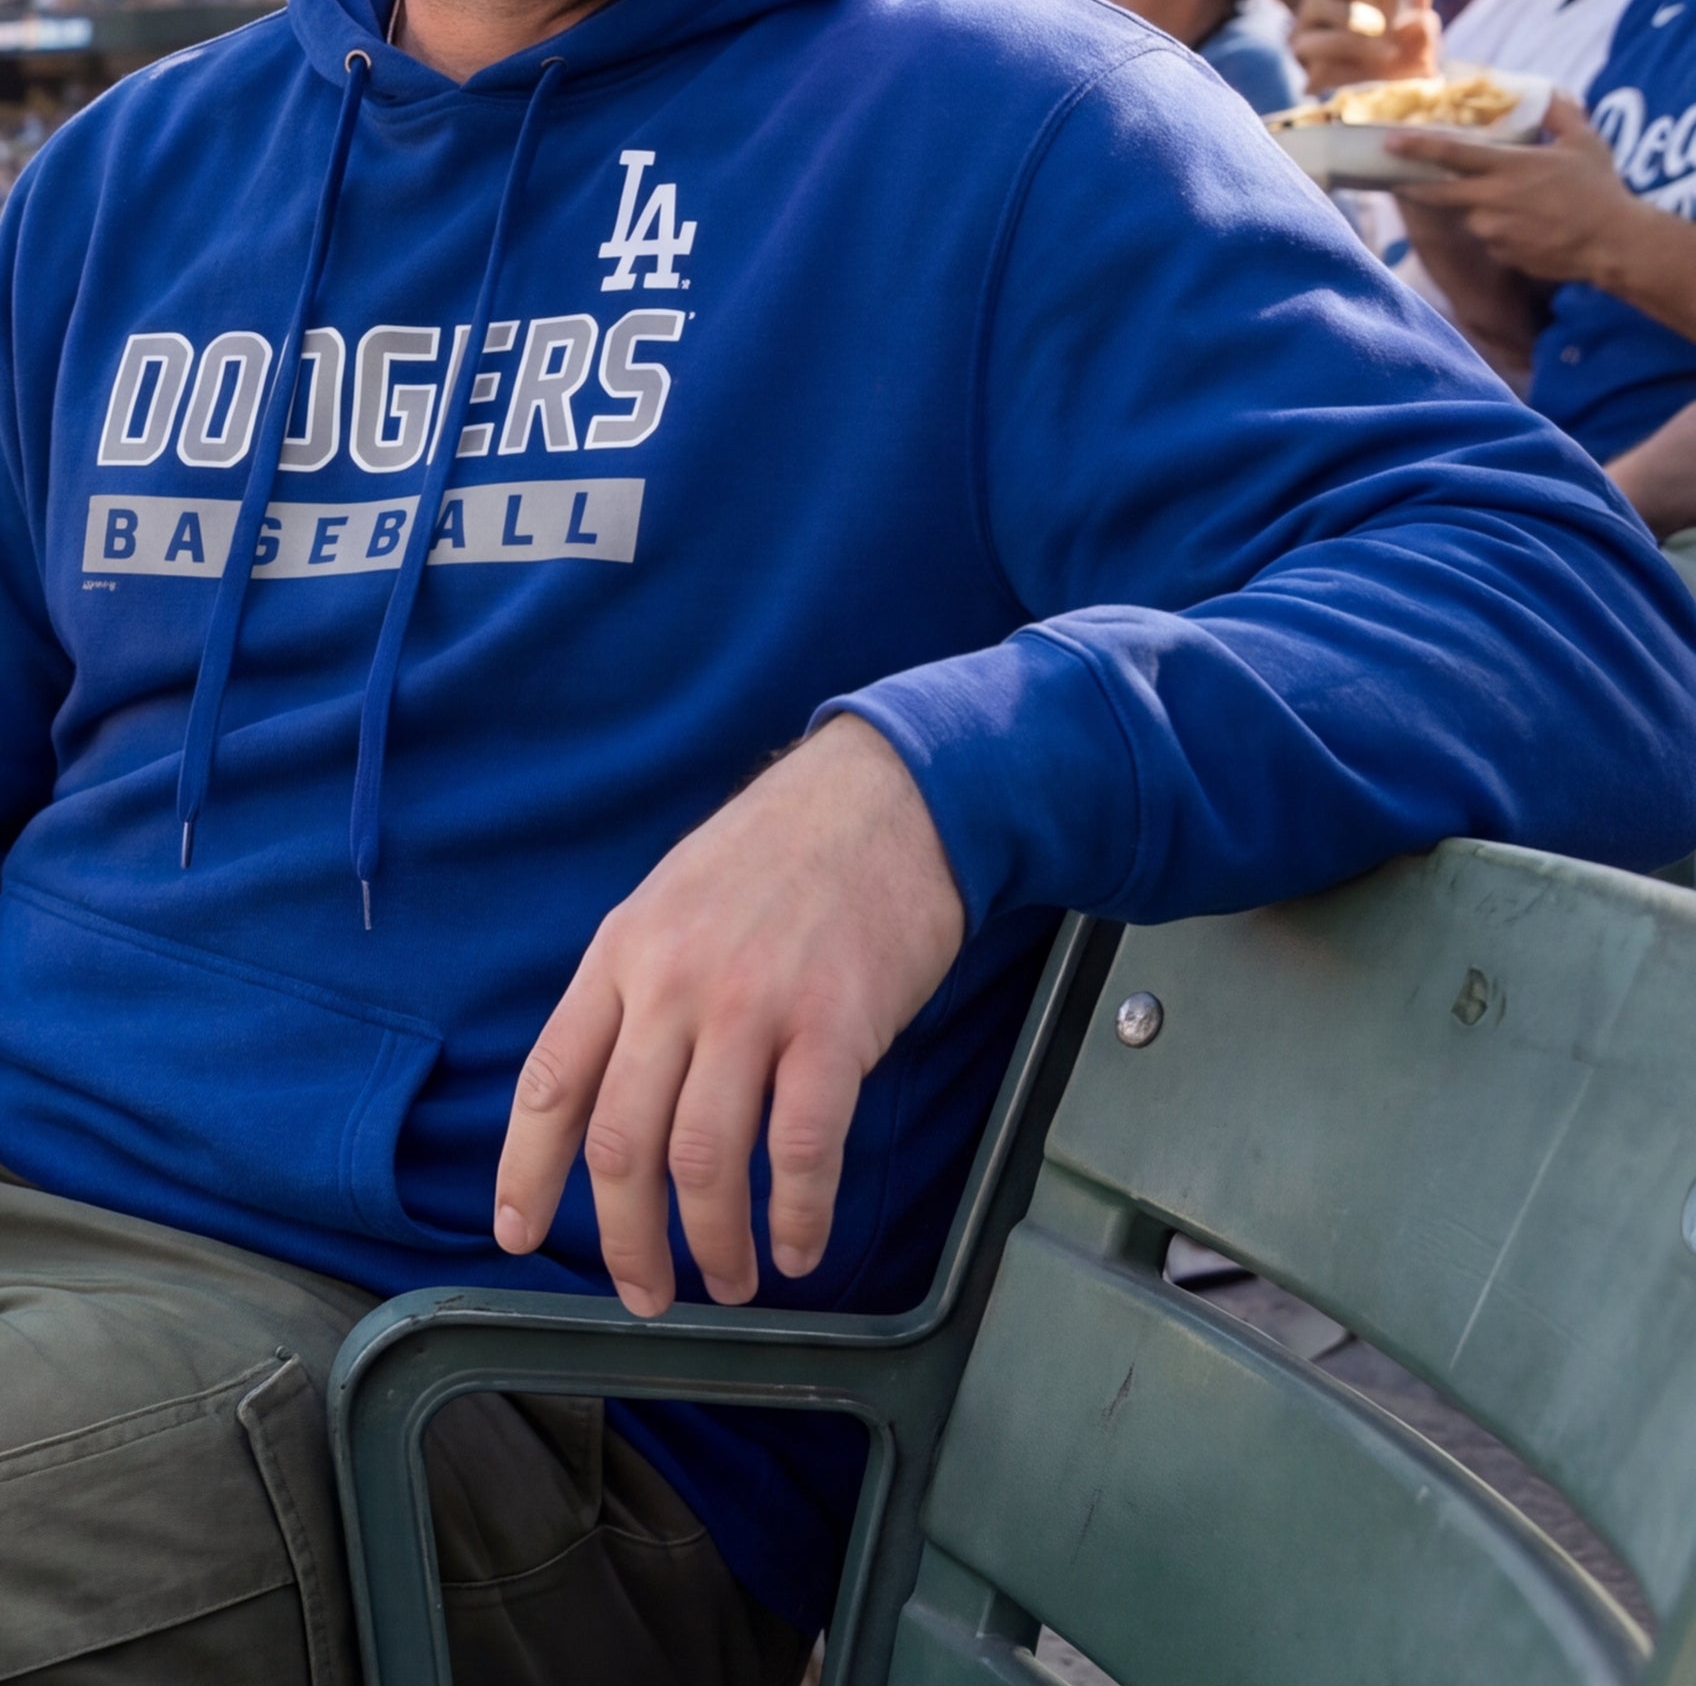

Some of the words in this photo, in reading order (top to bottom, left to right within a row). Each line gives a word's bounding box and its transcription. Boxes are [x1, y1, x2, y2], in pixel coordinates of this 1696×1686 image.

[598, 149, 698, 292] LA
[96, 308, 686, 474] DODGERS
[103, 491, 598, 566] BASEBALL
